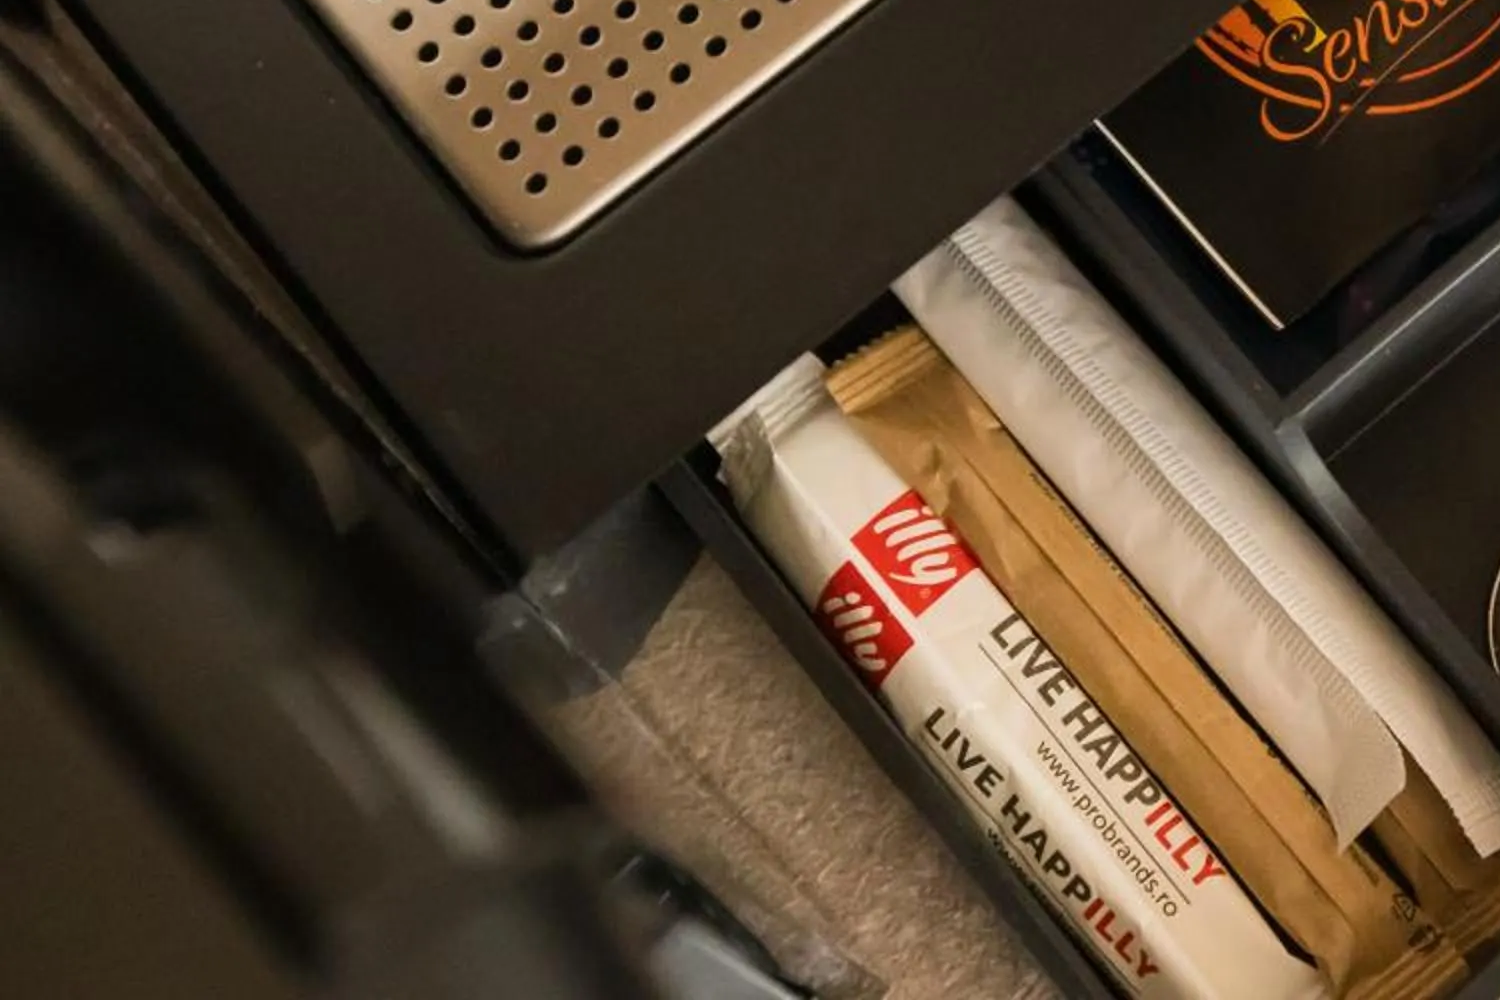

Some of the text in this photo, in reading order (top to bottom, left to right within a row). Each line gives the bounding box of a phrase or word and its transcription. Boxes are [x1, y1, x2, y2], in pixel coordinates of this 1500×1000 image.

[874, 504, 958, 587] illy
[924, 706, 1005, 800] LIVE
[1001, 784, 1160, 979] HAPPILLY
[989, 612, 1075, 709] LIVE
[1062, 697, 1227, 887] HAPPILLY
[1035, 739, 1179, 918] www.probrands.ro
